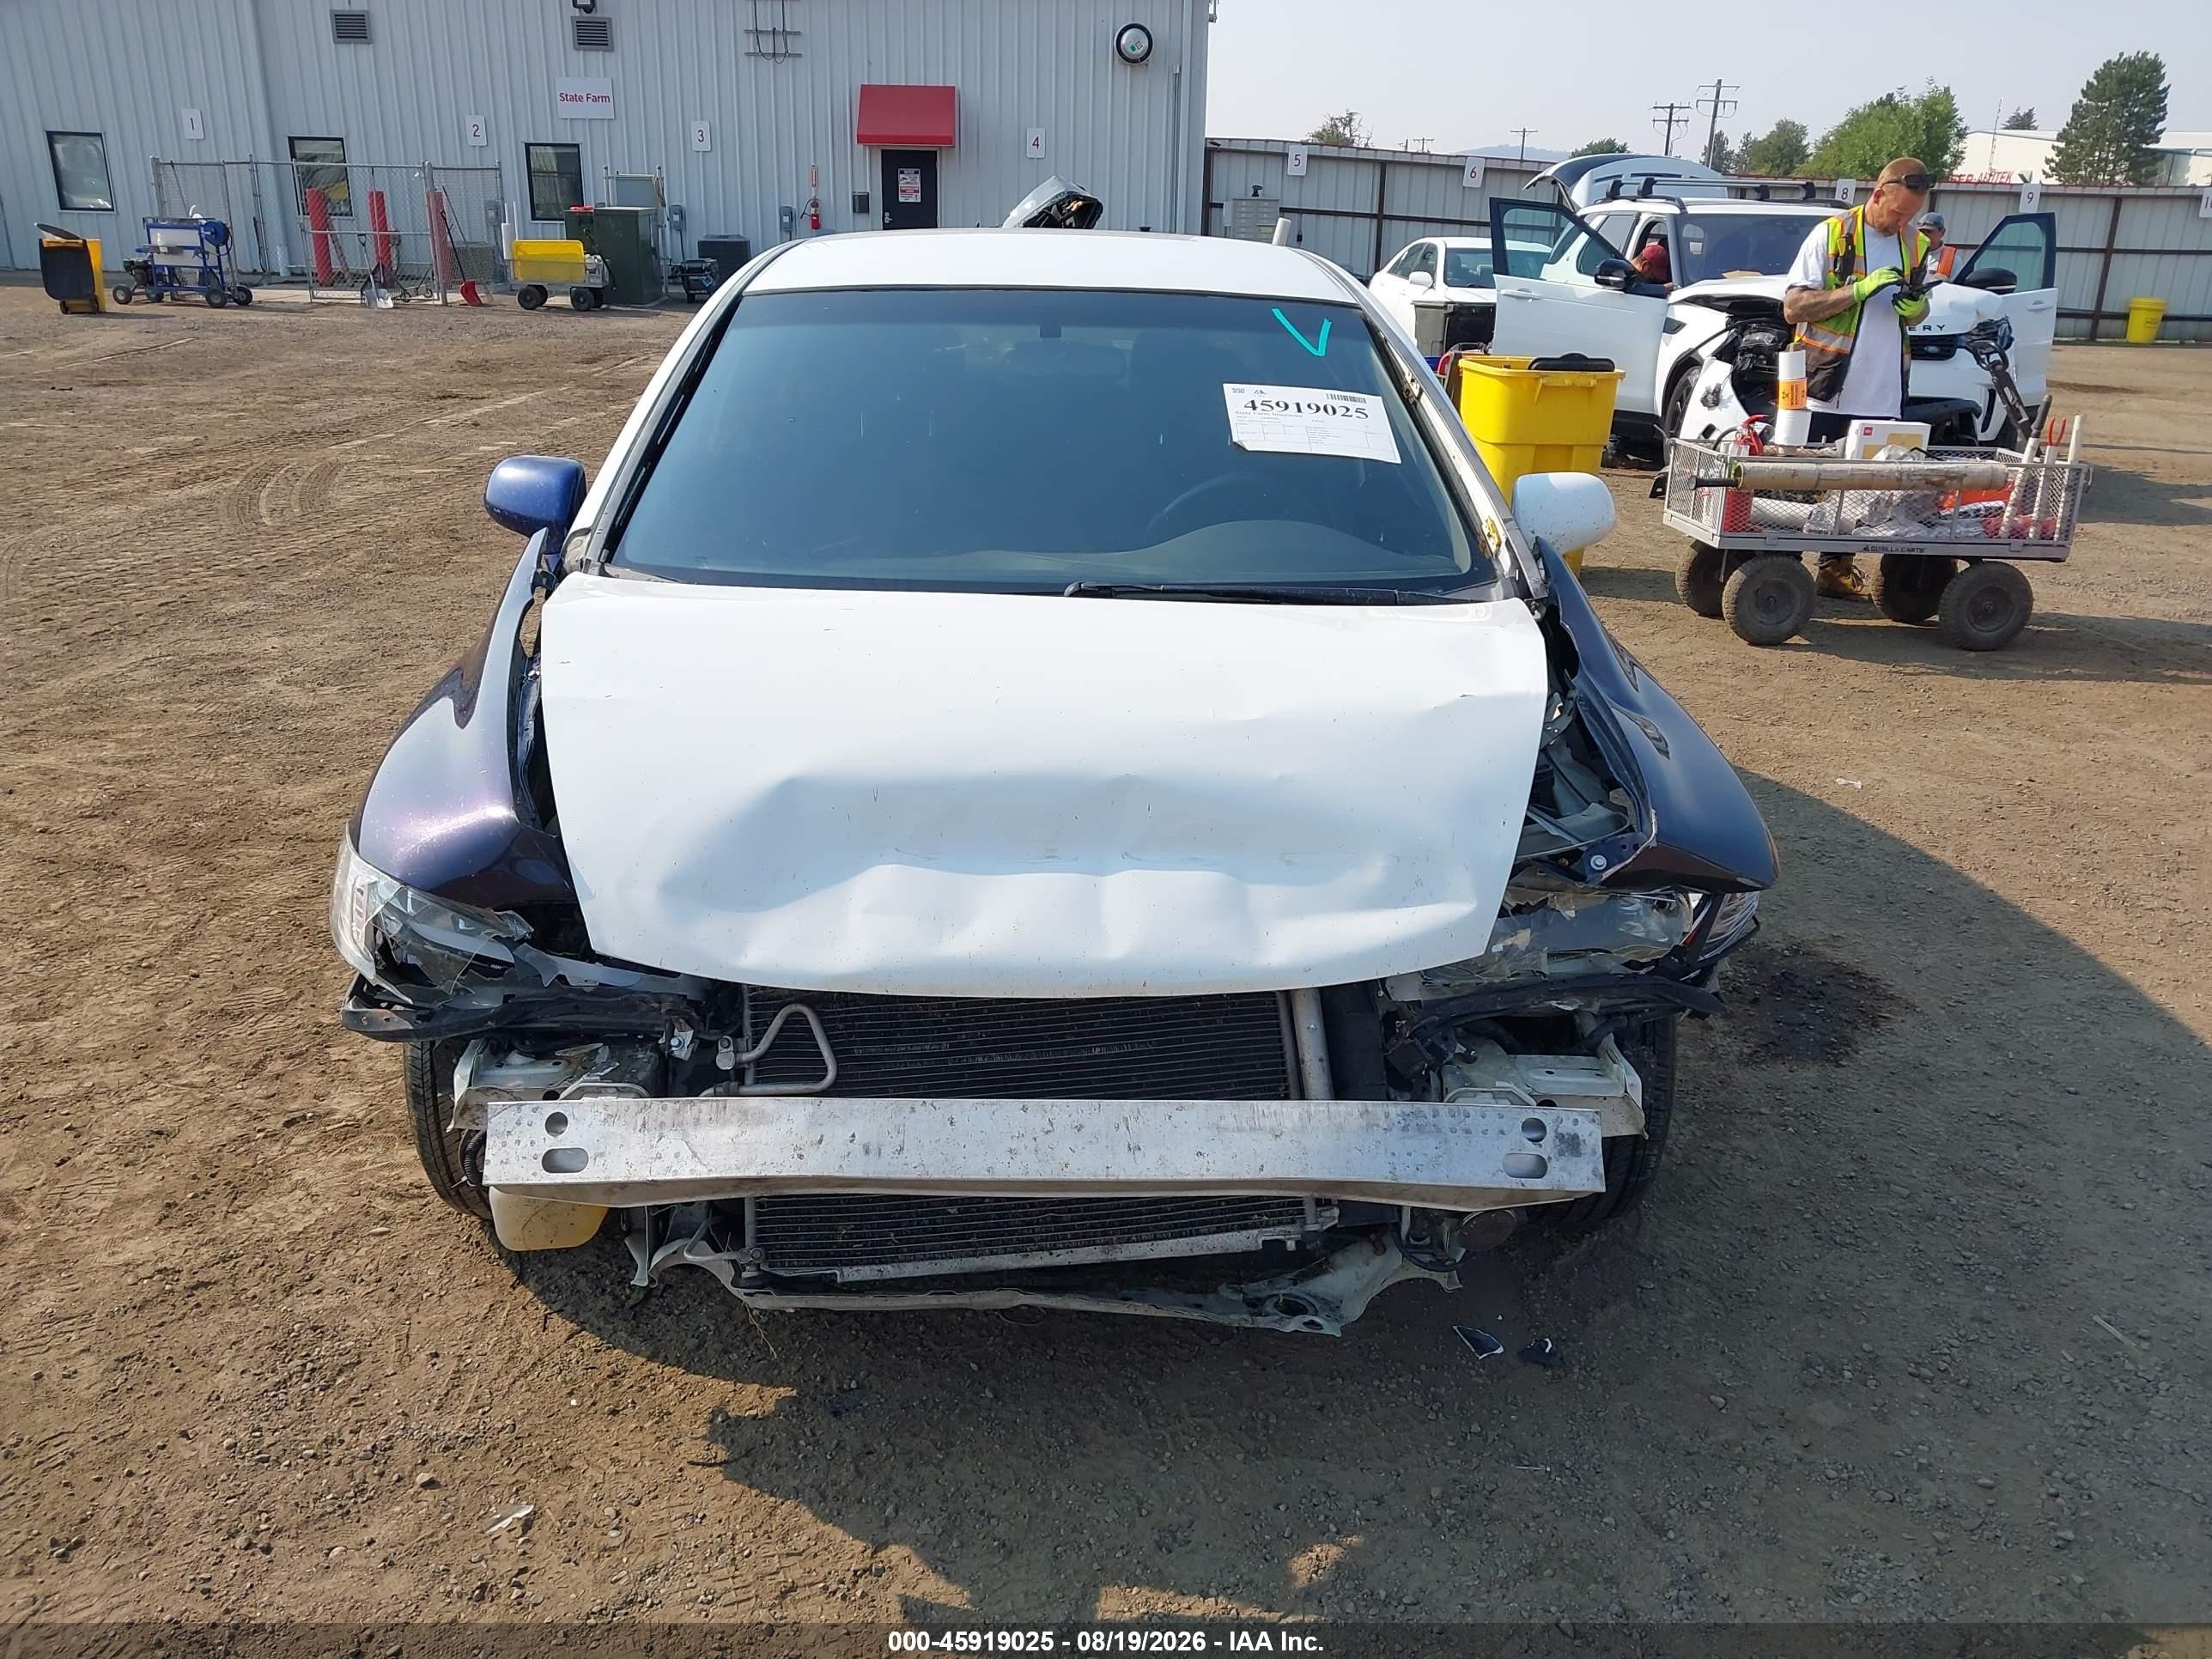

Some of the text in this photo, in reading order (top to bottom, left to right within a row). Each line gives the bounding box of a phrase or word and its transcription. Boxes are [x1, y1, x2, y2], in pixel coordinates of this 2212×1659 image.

[559, 92, 611, 103] State Farm
[190, 117, 195, 131] 1
[472, 124, 481, 137] 2
[697, 129, 705, 143] 3
[1032, 136, 1039, 149] 4
[1294, 154, 1301, 167] 5
[1469, 166, 1476, 179] 6
[1841, 187, 1848, 200] 8
[2027, 191, 2033, 204] 9
[1244, 399, 1369, 419] 45919025
